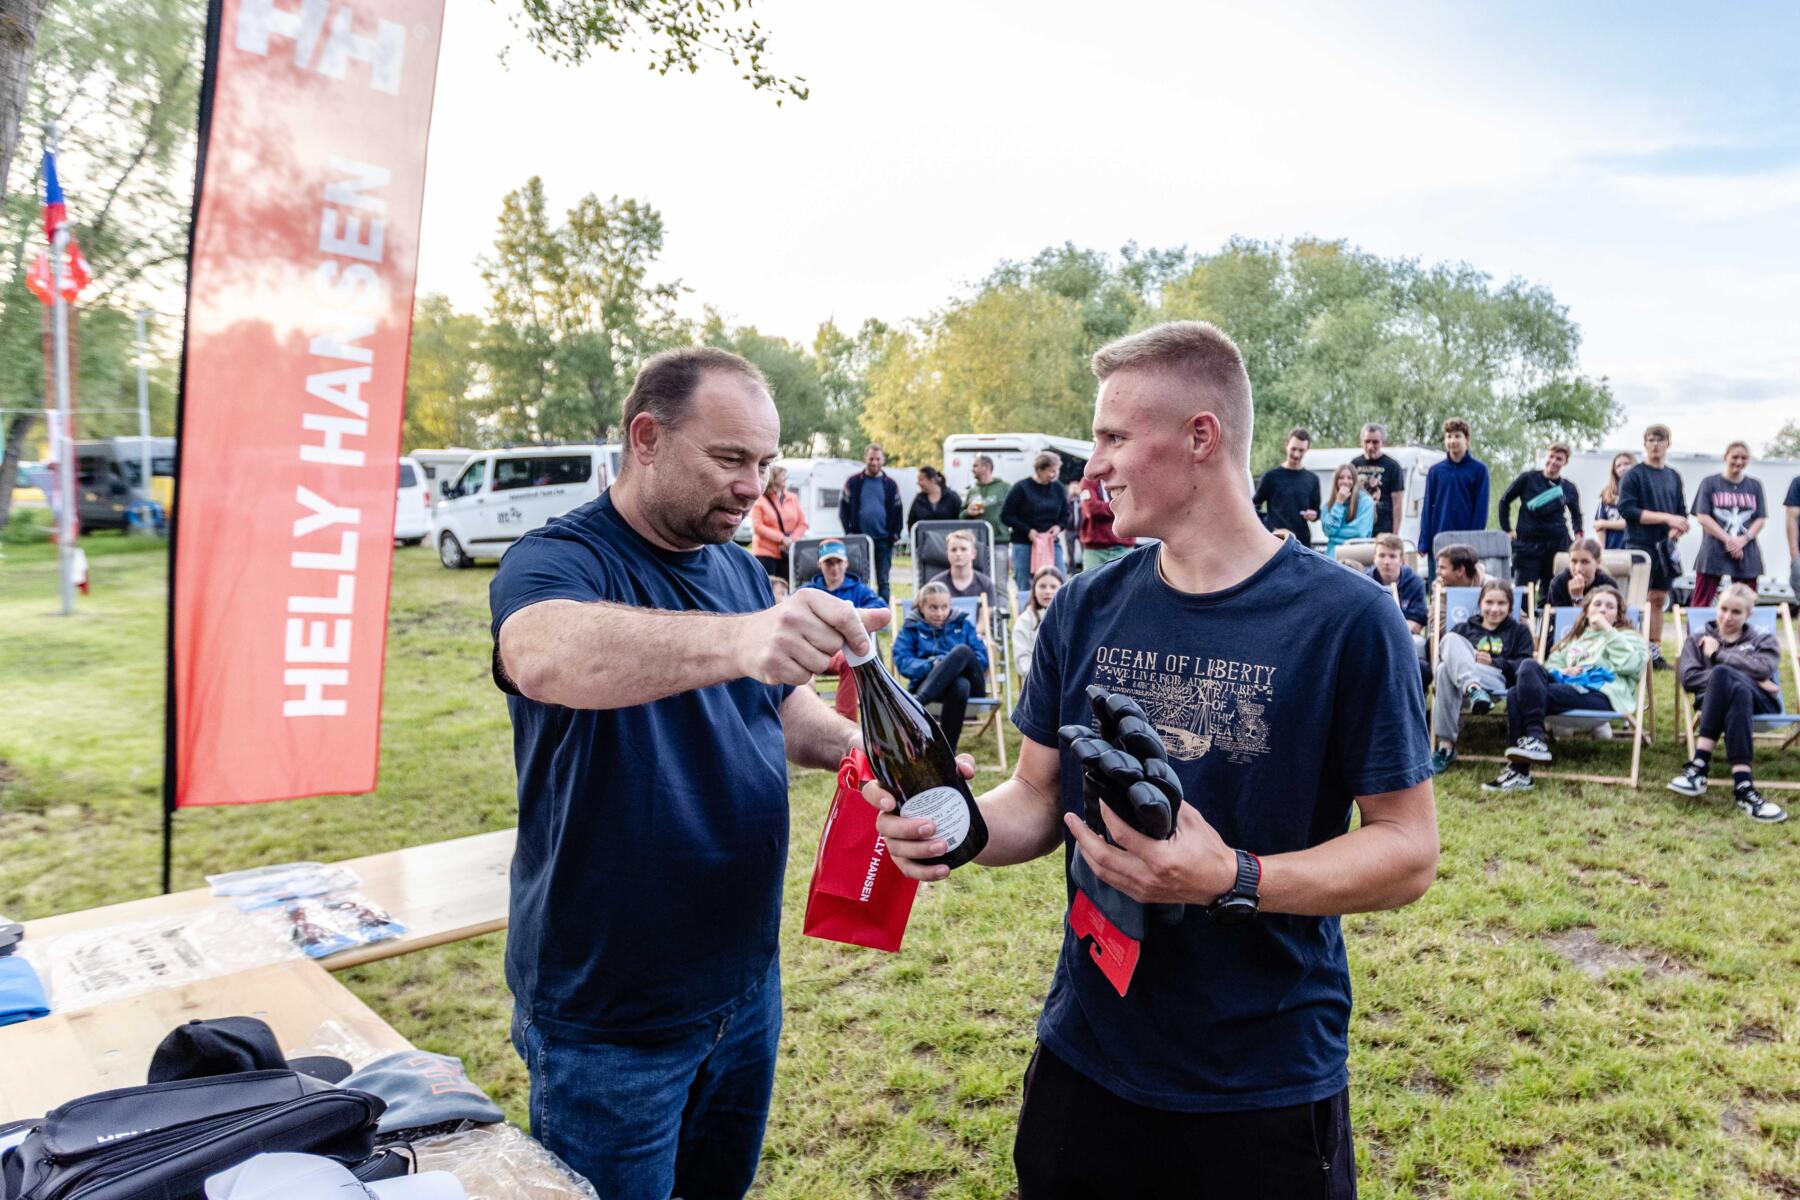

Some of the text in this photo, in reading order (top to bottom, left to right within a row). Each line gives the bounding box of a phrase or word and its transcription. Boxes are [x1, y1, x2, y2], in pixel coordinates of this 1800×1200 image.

[283, 154, 391, 717] HELLY HANSEN
[1096, 646, 1277, 686] OCEAN OF LIBERTY
[1112, 667, 1131, 679] WE
[1132, 670, 1157, 682] LIVE
[1159, 673, 1182, 686] FOR
[1212, 700, 1228, 711] OF
[1210, 723, 1232, 736] SEA
[859, 834, 886, 902] LLY HANSEN
